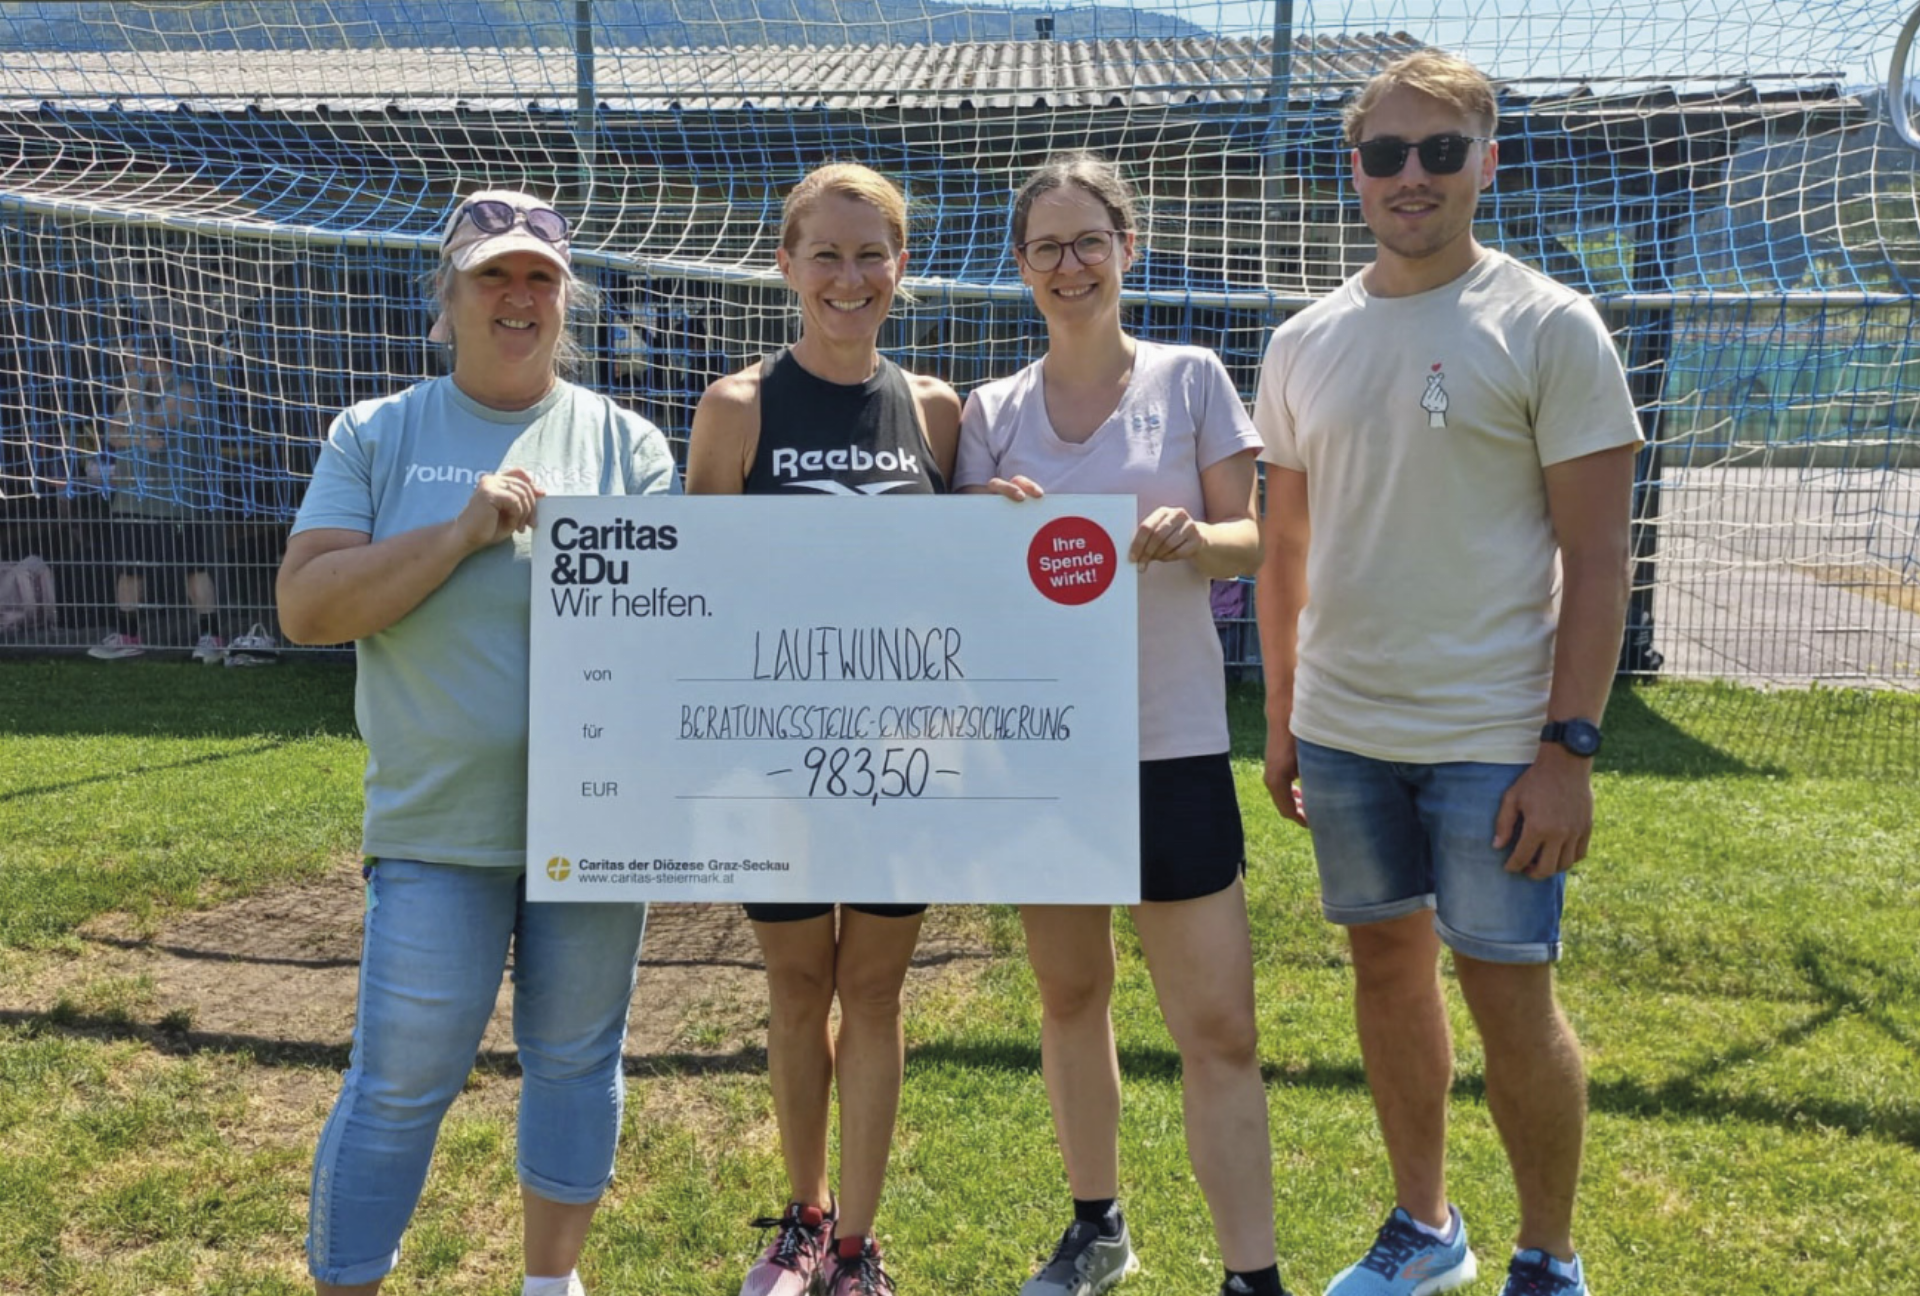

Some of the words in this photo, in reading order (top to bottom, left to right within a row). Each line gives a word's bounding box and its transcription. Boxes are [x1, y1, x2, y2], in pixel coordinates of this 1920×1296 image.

[772, 444, 920, 478] Reebok
[551, 517, 678, 551] Caritas
[1052, 537, 1087, 553] Ihre
[551, 553, 629, 585] &Du
[1039, 551, 1105, 574] Spende
[1049, 568, 1098, 588] wirkt!
[551, 587, 602, 617] Wir
[611, 587, 713, 618] helfen.
[753, 626, 965, 682] LAUFWUNDER
[583, 669, 612, 682] von
[582, 724, 604, 739] für
[581, 781, 618, 797] EUR
[578, 858, 625, 872] Caritas
[628, 858, 650, 872] der
[653, 857, 705, 872] Diözese
[707, 858, 790, 872] Graz-Seckau
[578, 872, 735, 885] www.caritas-steiermark.at
